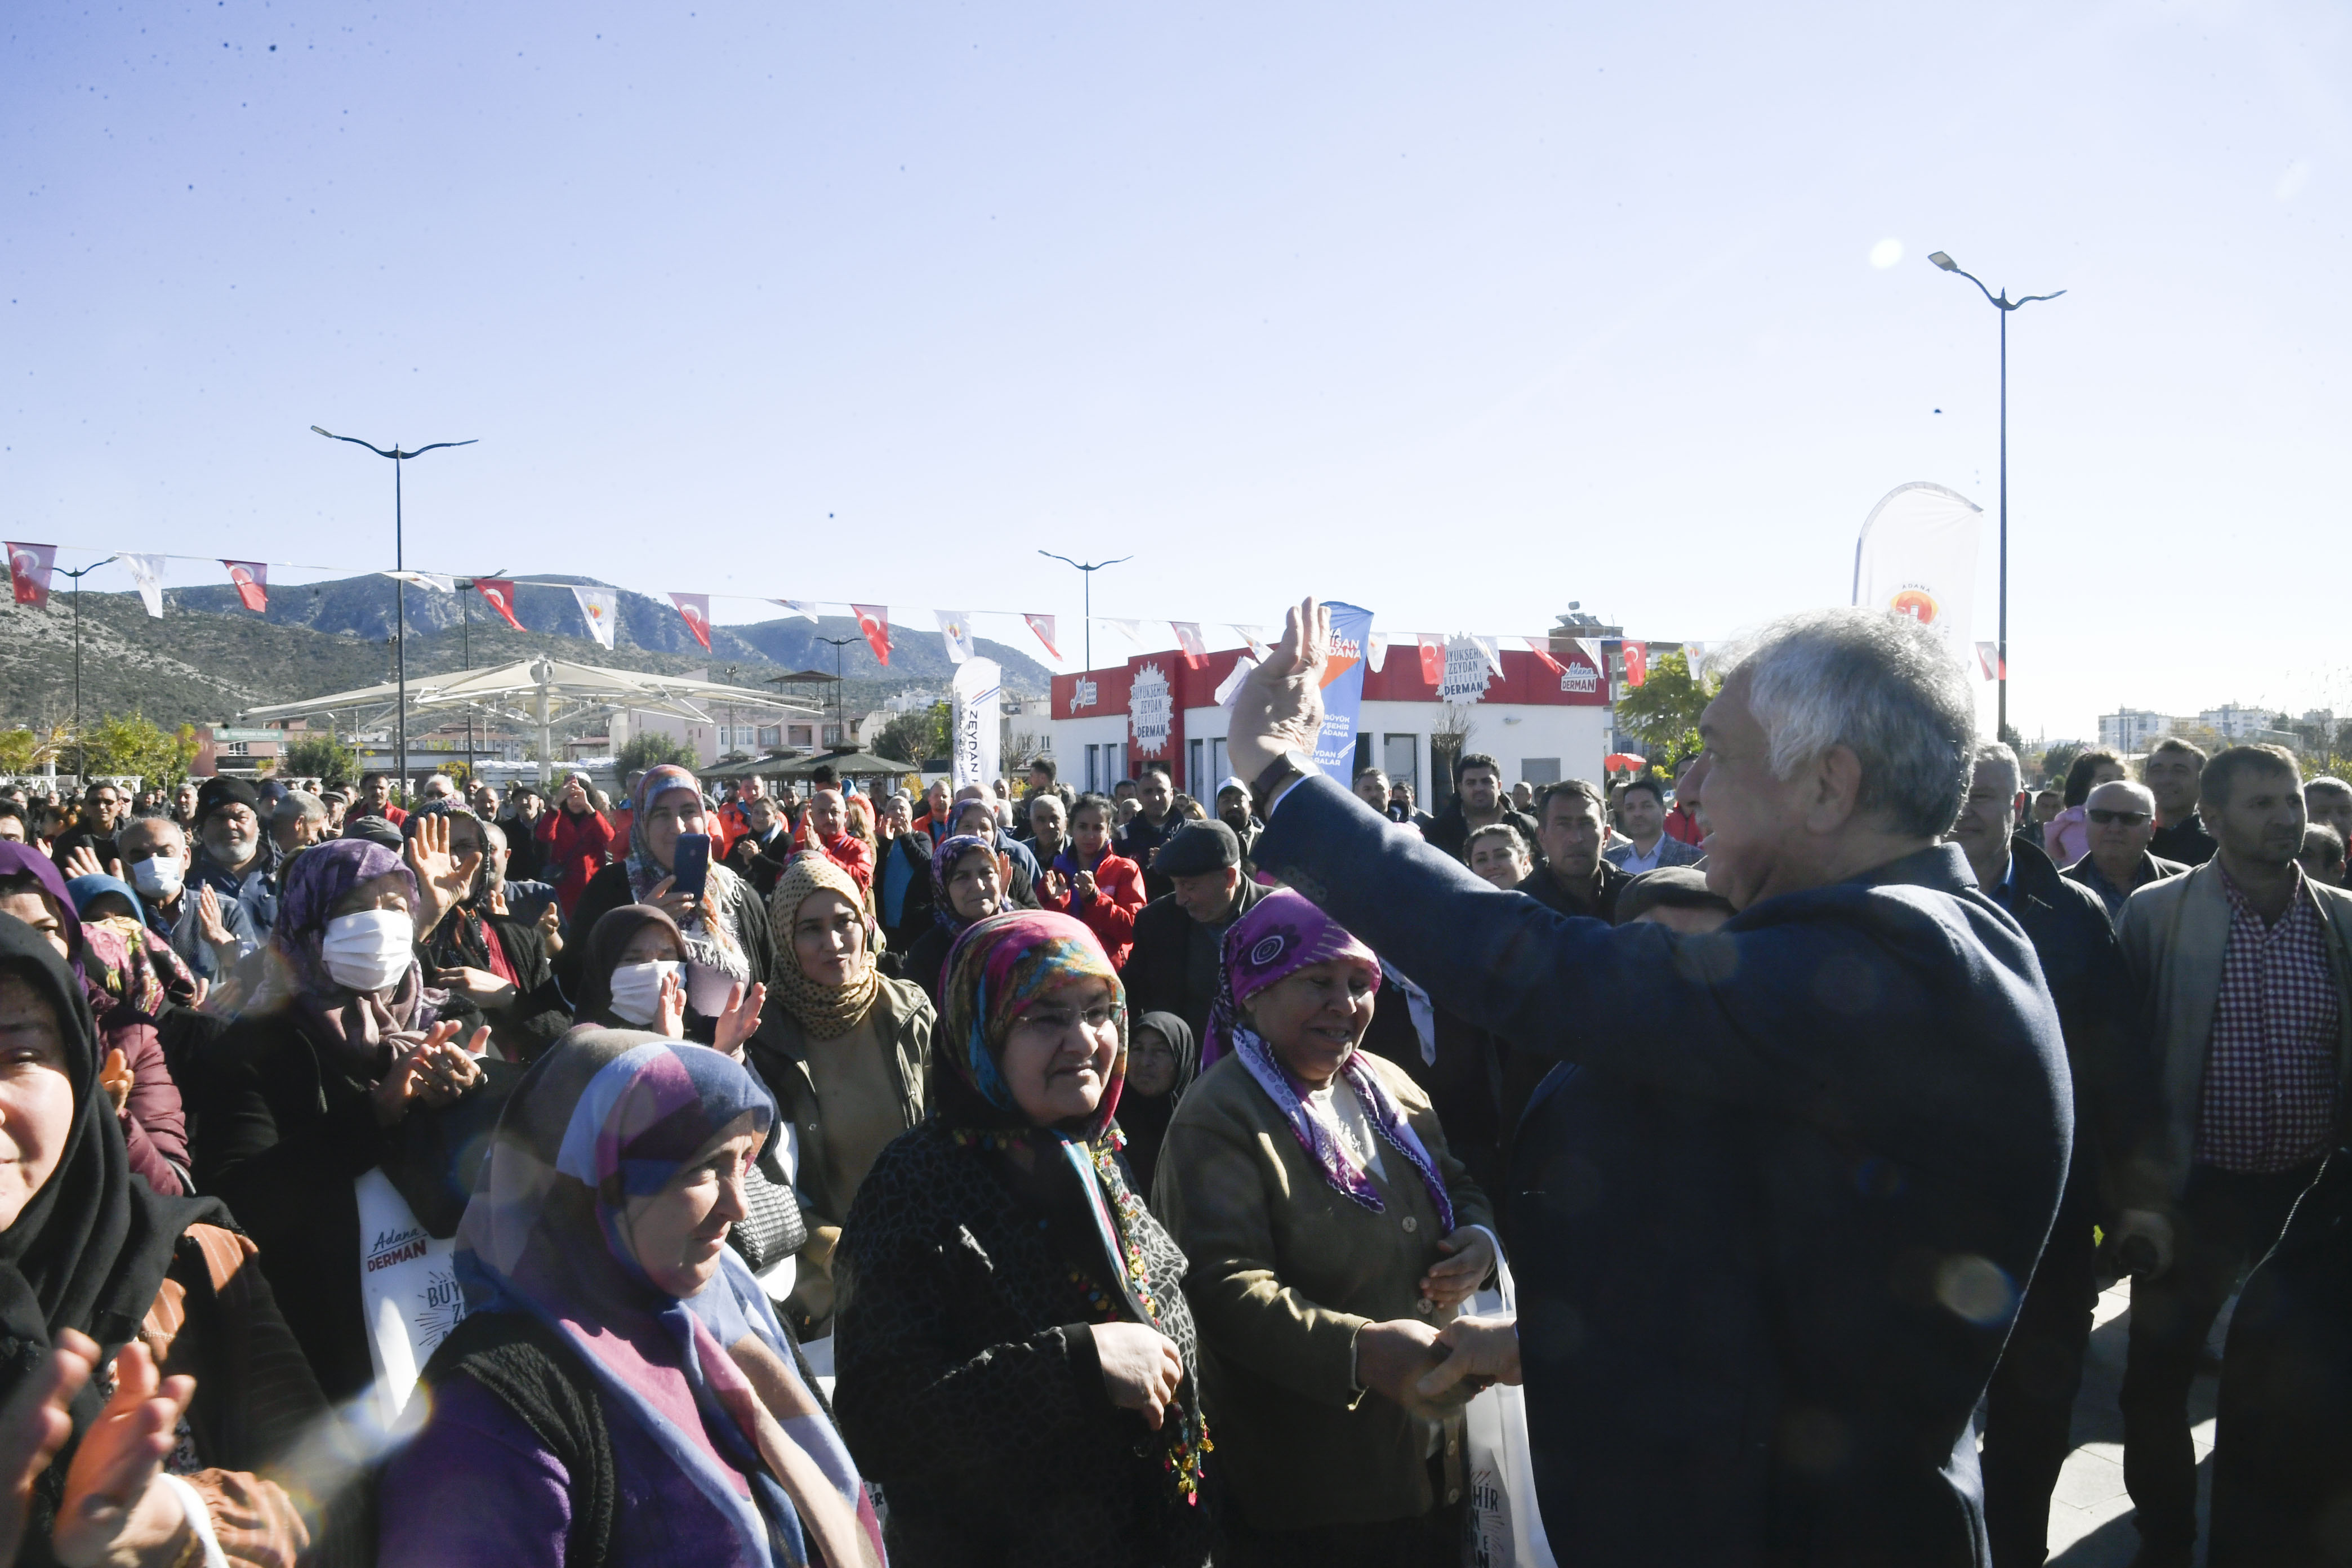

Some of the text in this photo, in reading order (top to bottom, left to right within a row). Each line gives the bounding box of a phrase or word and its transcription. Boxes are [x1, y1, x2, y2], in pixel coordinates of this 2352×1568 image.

[1902, 583, 1930, 593] ADANA
[1330, 638, 1360, 649] IŞAN
[1329, 647, 1361, 660] DANA
[1445, 648, 1484, 662] ÜYÜKŞEHİ
[1449, 661, 1478, 675] ZEYDAN
[1444, 681, 1484, 696] DERMAN
[1562, 679, 1595, 691] DERMAN
[1141, 698, 1162, 715] ZEYDAN
[1324, 714, 1350, 723] BÜYÜK
[1326, 721, 1349, 730] ŞEHİR
[1137, 724, 1166, 738] DERMAN
[1322, 729, 1348, 738] ADANA
[968, 710, 979, 772] ZEYDAN
[1313, 750, 1337, 758] YDAN
[1312, 757, 1341, 767] RALAR
[372, 1227, 420, 1253] Adana
[367, 1239, 427, 1273] DERMAN
[427, 1279, 460, 1308] BÜY
[1473, 1481, 1499, 1512] HİR
